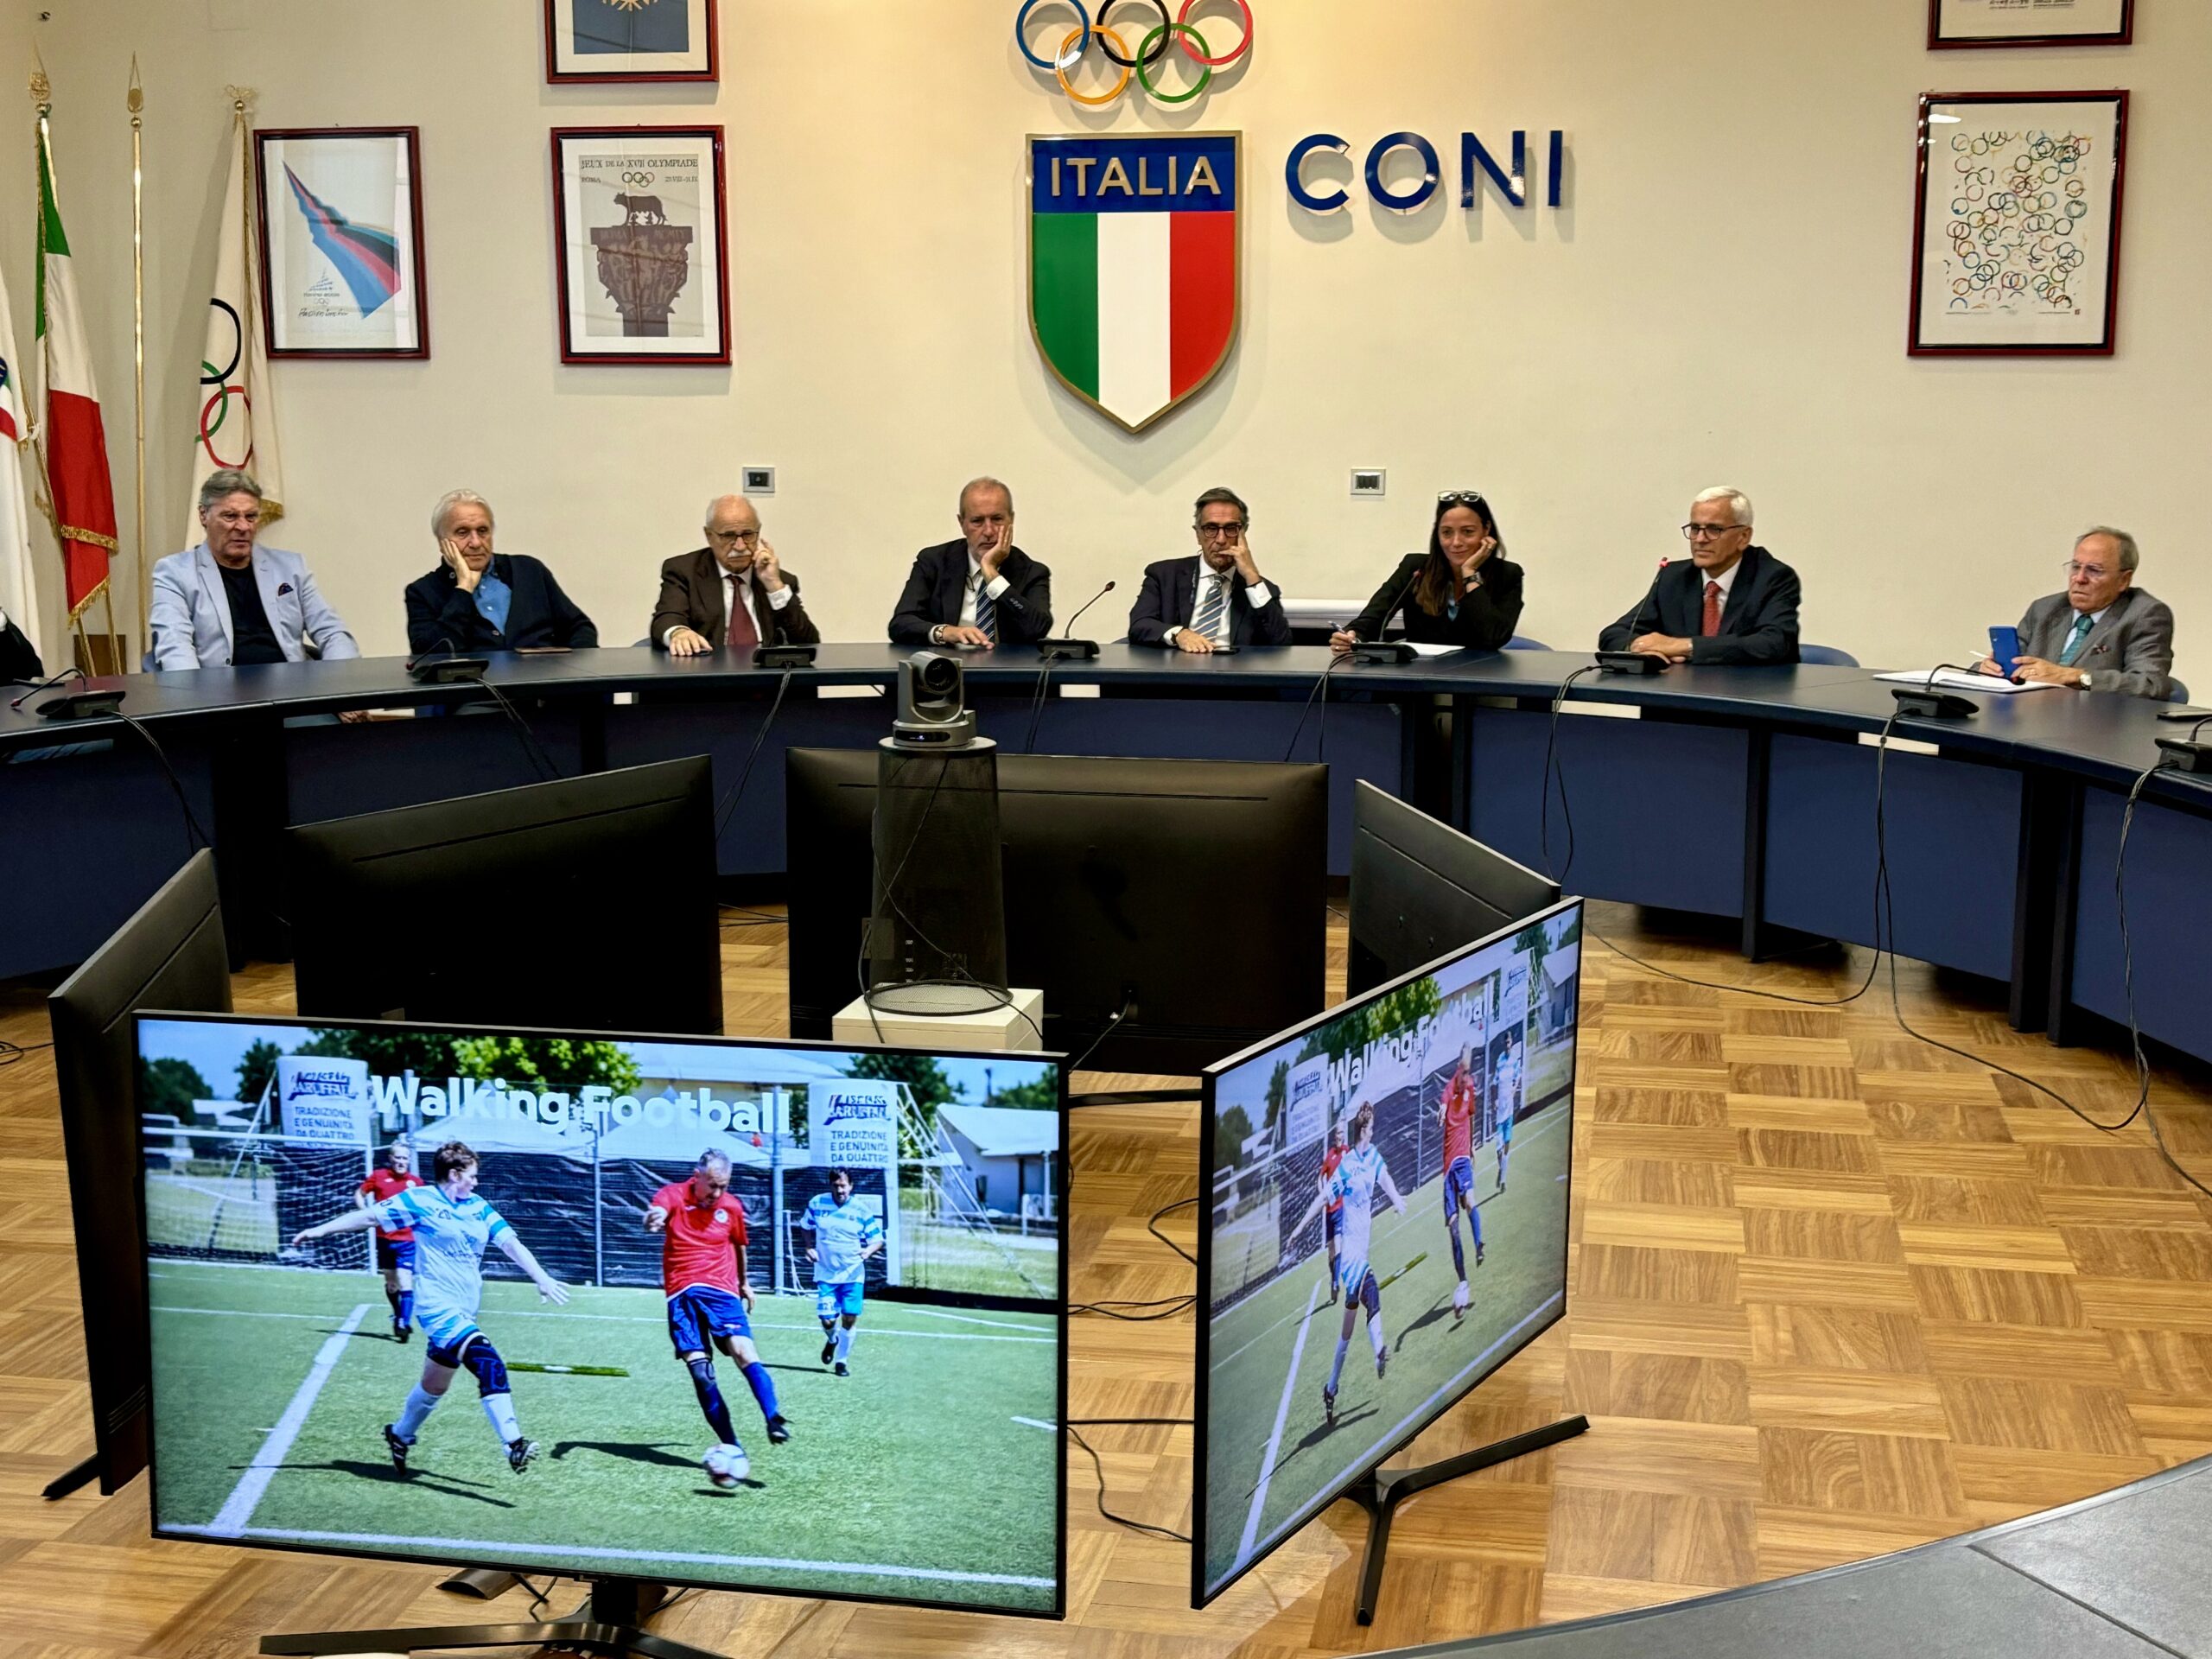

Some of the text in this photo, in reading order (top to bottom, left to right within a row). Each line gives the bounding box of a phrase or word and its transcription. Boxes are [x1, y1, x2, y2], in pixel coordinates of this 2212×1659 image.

[581, 160, 602, 168] JEUX
[647, 159, 698, 168] OLYMPIADE
[1051, 156, 1222, 196] ITALIA
[1285, 130, 1563, 210] CONI
[1416, 978, 1495, 1049] Fotball
[371, 1075, 570, 1135] Walking
[582, 1085, 791, 1134] Football
[295, 1106, 353, 1119] TRADIZIONE
[294, 1117, 301, 1127] E
[831, 1130, 887, 1141] TRADIZIONE
[830, 1141, 836, 1151] E
[831, 1153, 888, 1164] DA QUATTRO
